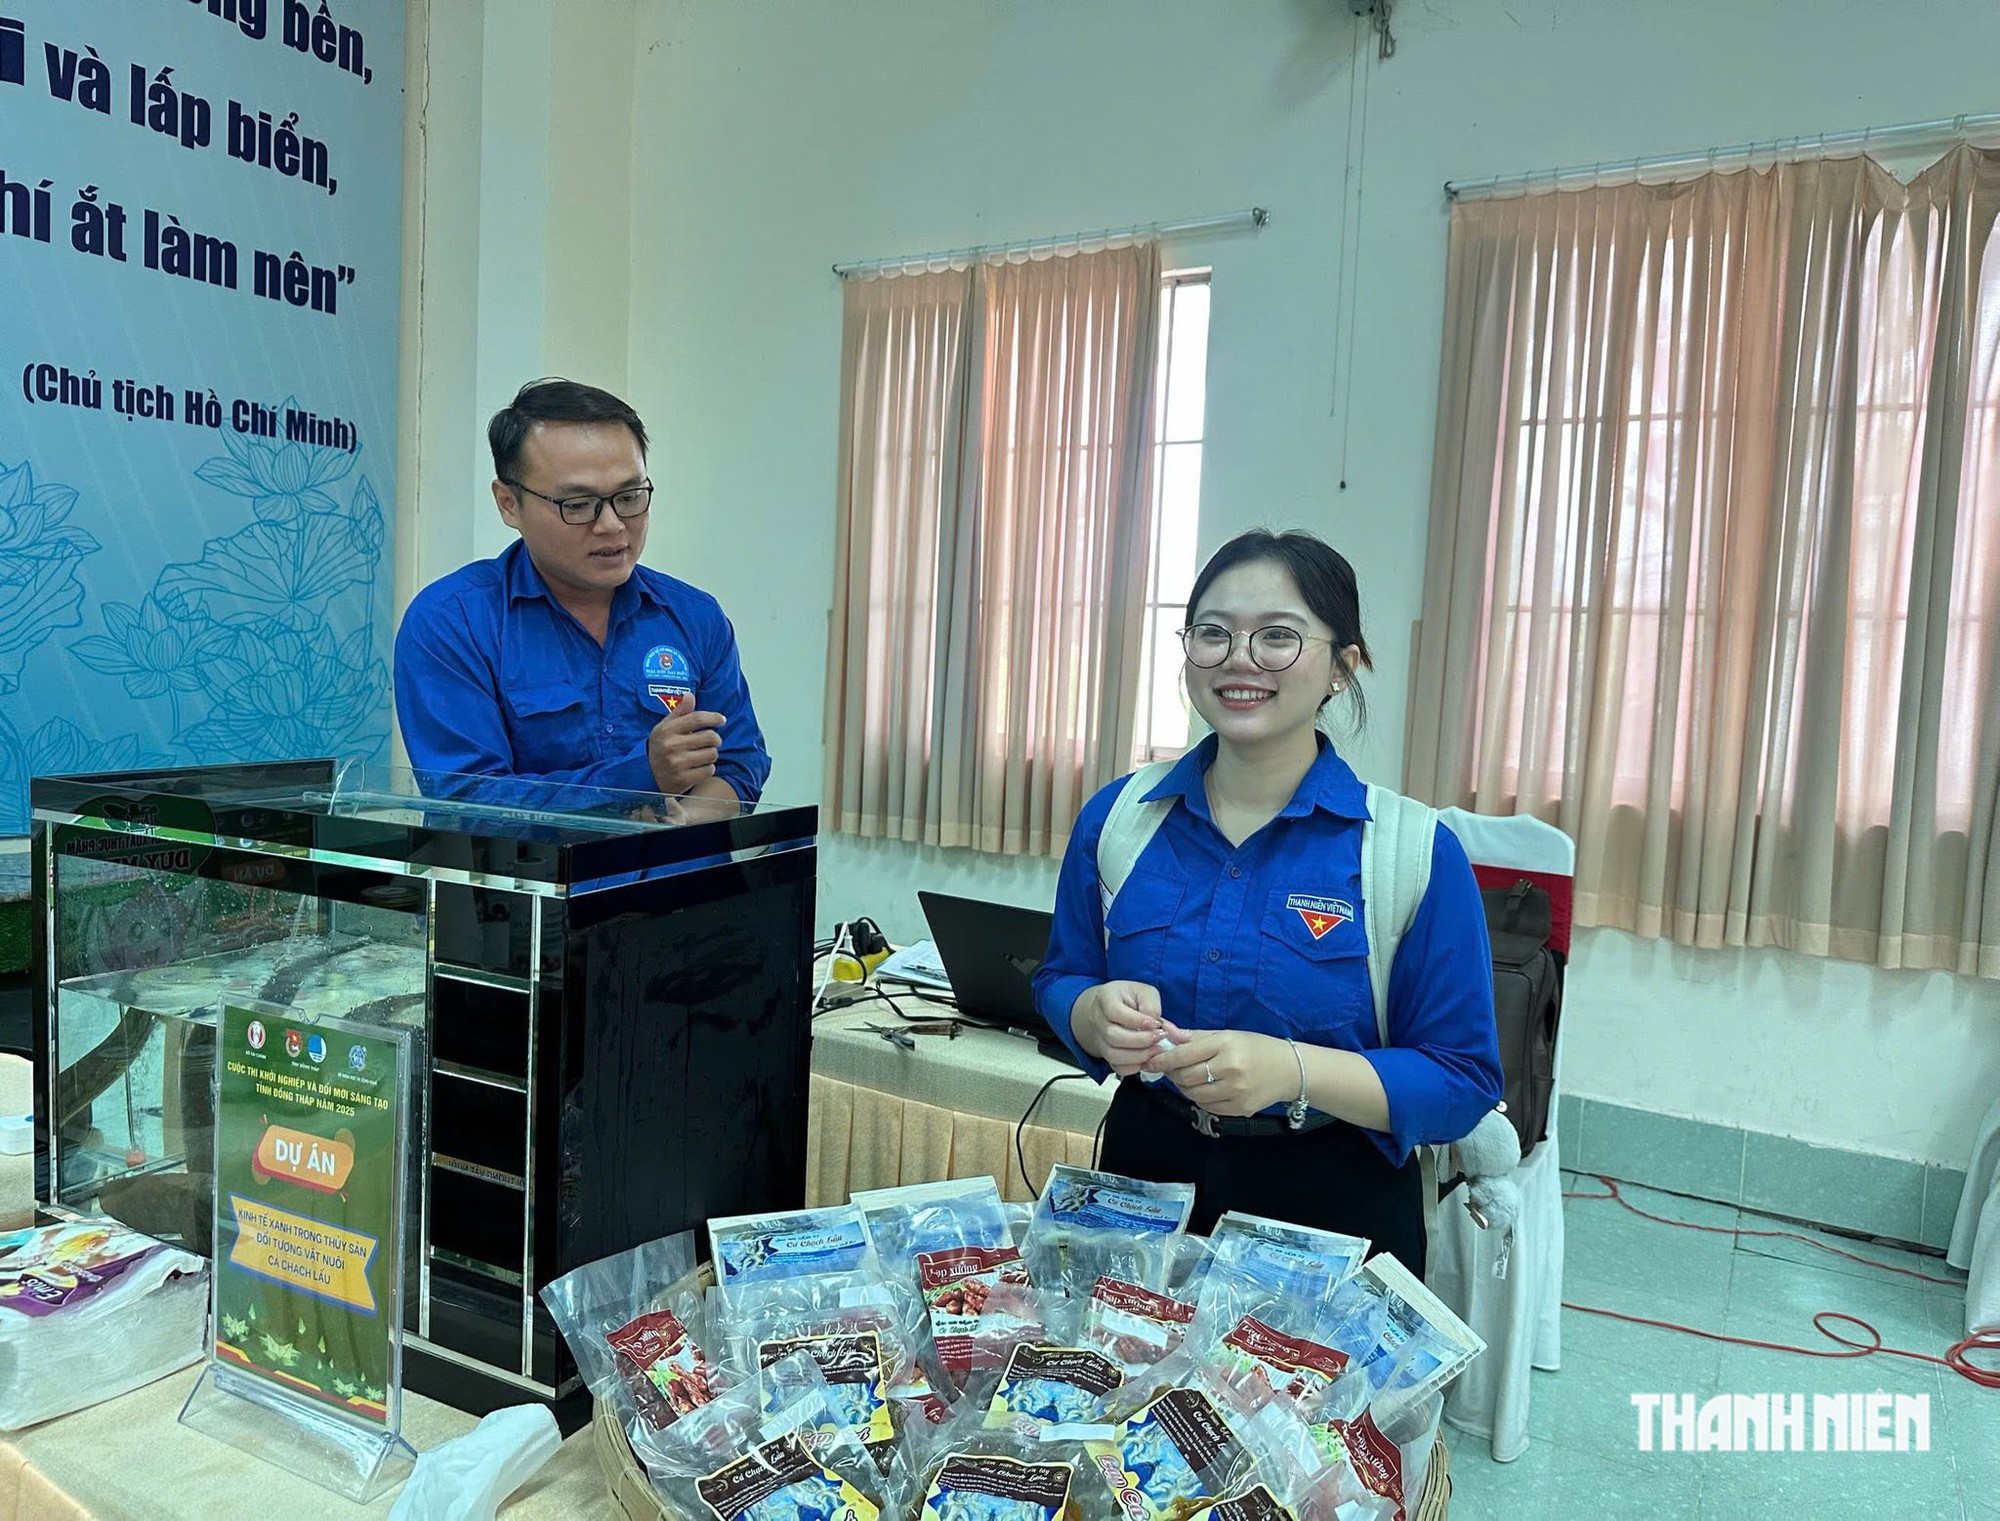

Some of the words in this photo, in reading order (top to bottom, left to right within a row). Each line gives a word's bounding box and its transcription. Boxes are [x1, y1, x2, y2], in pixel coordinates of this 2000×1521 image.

[44, 42, 111, 115] và
[130, 63, 211, 149] lấp
[228, 99, 338, 196] biển,
[0, 170, 54, 243] hí
[70, 185, 127, 262] ắt
[143, 208, 238, 290] làm
[22, 362, 102, 409] (Chủ
[112, 378, 174, 421] tịch
[184, 389, 222, 428] Hồ
[232, 399, 278, 438] Chí
[286, 408, 356, 454] Minh)
[227, 1061, 246, 1075] CUỘC
[247, 1066, 258, 1077] THI
[259, 1068, 277, 1081] KHỞI
[278, 1074, 305, 1089] NGHIỆP
[307, 1080, 318, 1093] VÀ
[350, 1090, 371, 1106] SÁNG
[374, 1097, 389, 1111] TẠO
[255, 1081, 272, 1095] TỈNH
[273, 1086, 294, 1102] ĐỒNG
[336, 1104, 355, 1117] 2025
[275, 1138, 303, 1172] DỰ
[307, 1142, 335, 1176] ÁN
[238, 1208, 257, 1223] KINH
[258, 1212, 269, 1227] TẾ
[269, 1218, 292, 1234] XANH
[293, 1226, 322, 1244] TRONG
[256, 1231, 271, 1246] ĐỐI
[322, 1253, 345, 1270] NUÔI
[268, 1253, 279, 1267] CÁ
[281, 1258, 312, 1278] CHẠCH
[313, 1267, 331, 1285] LẤU
